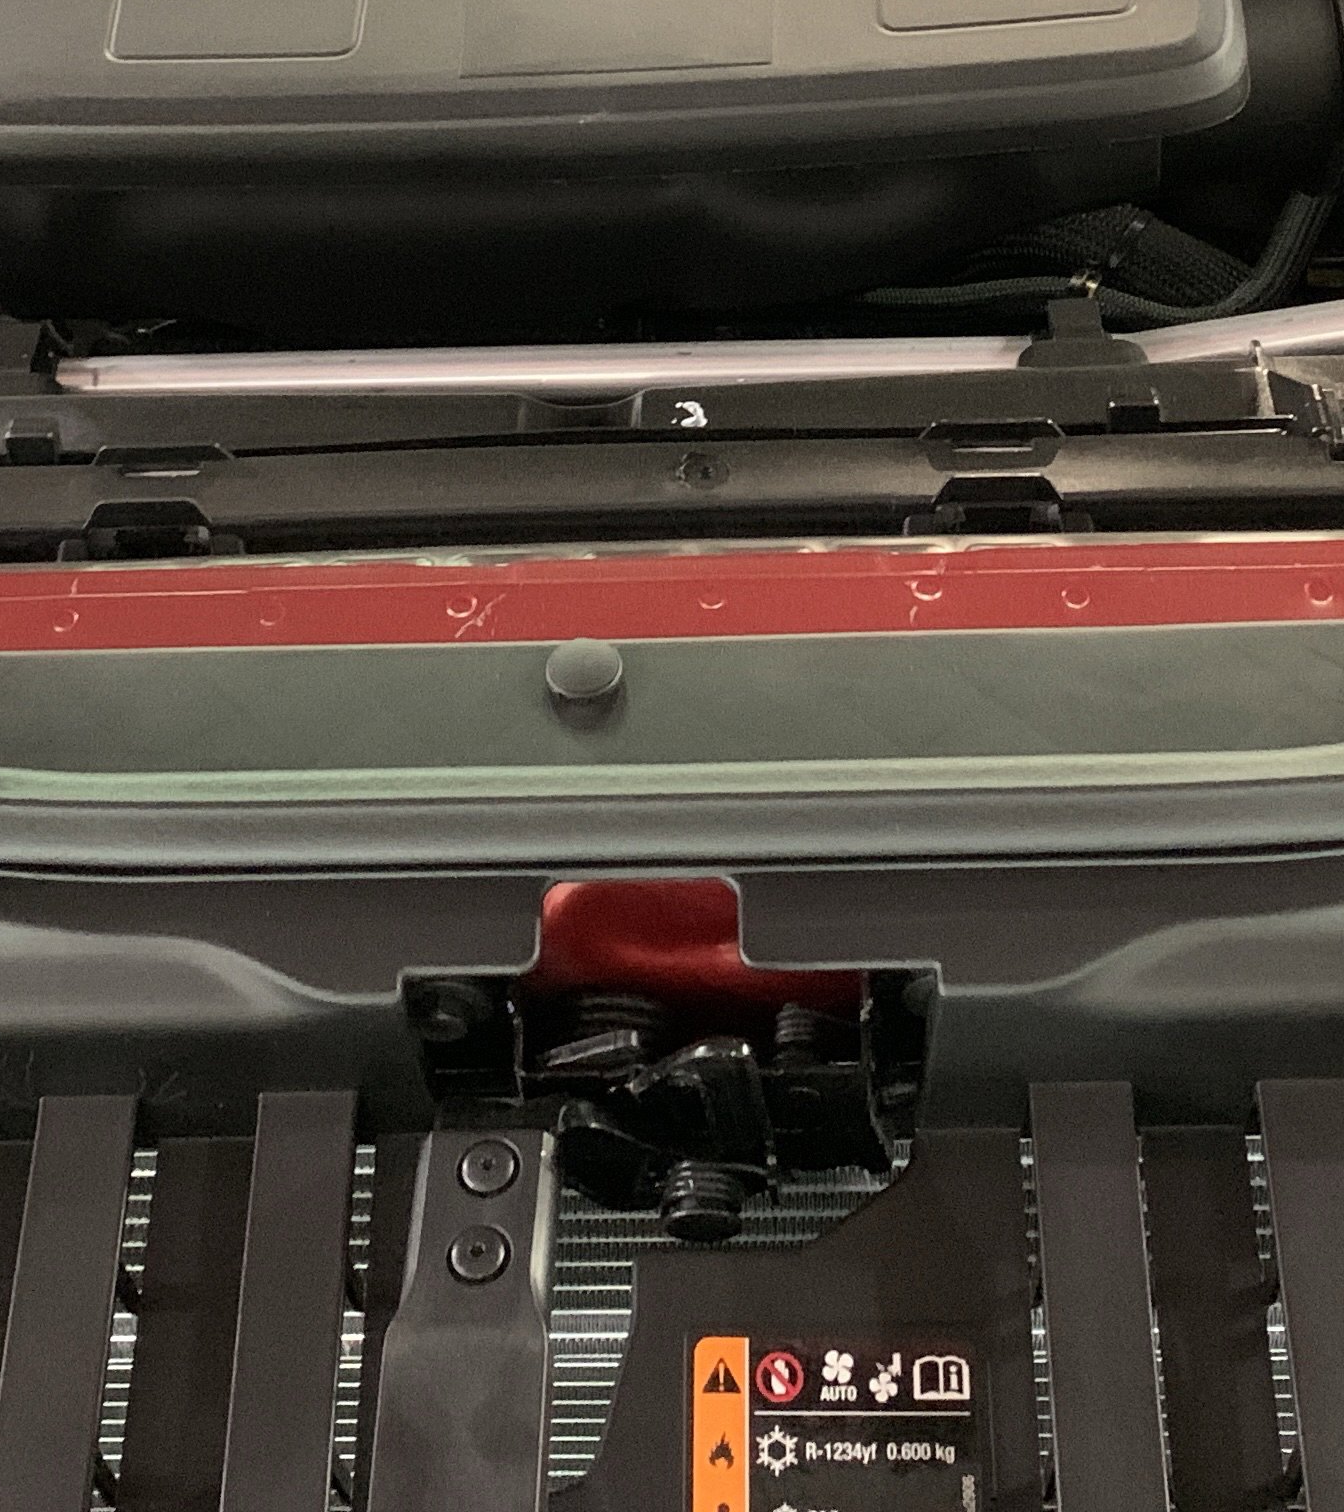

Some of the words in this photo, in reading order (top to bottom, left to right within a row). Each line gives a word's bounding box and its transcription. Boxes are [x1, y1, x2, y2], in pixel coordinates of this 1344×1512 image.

[820, 1385, 857, 1402] AUTO
[805, 1441, 878, 1465] R-1234yf
[886, 1441, 932, 1461] 0.600
[934, 1442, 956, 1465] kg
